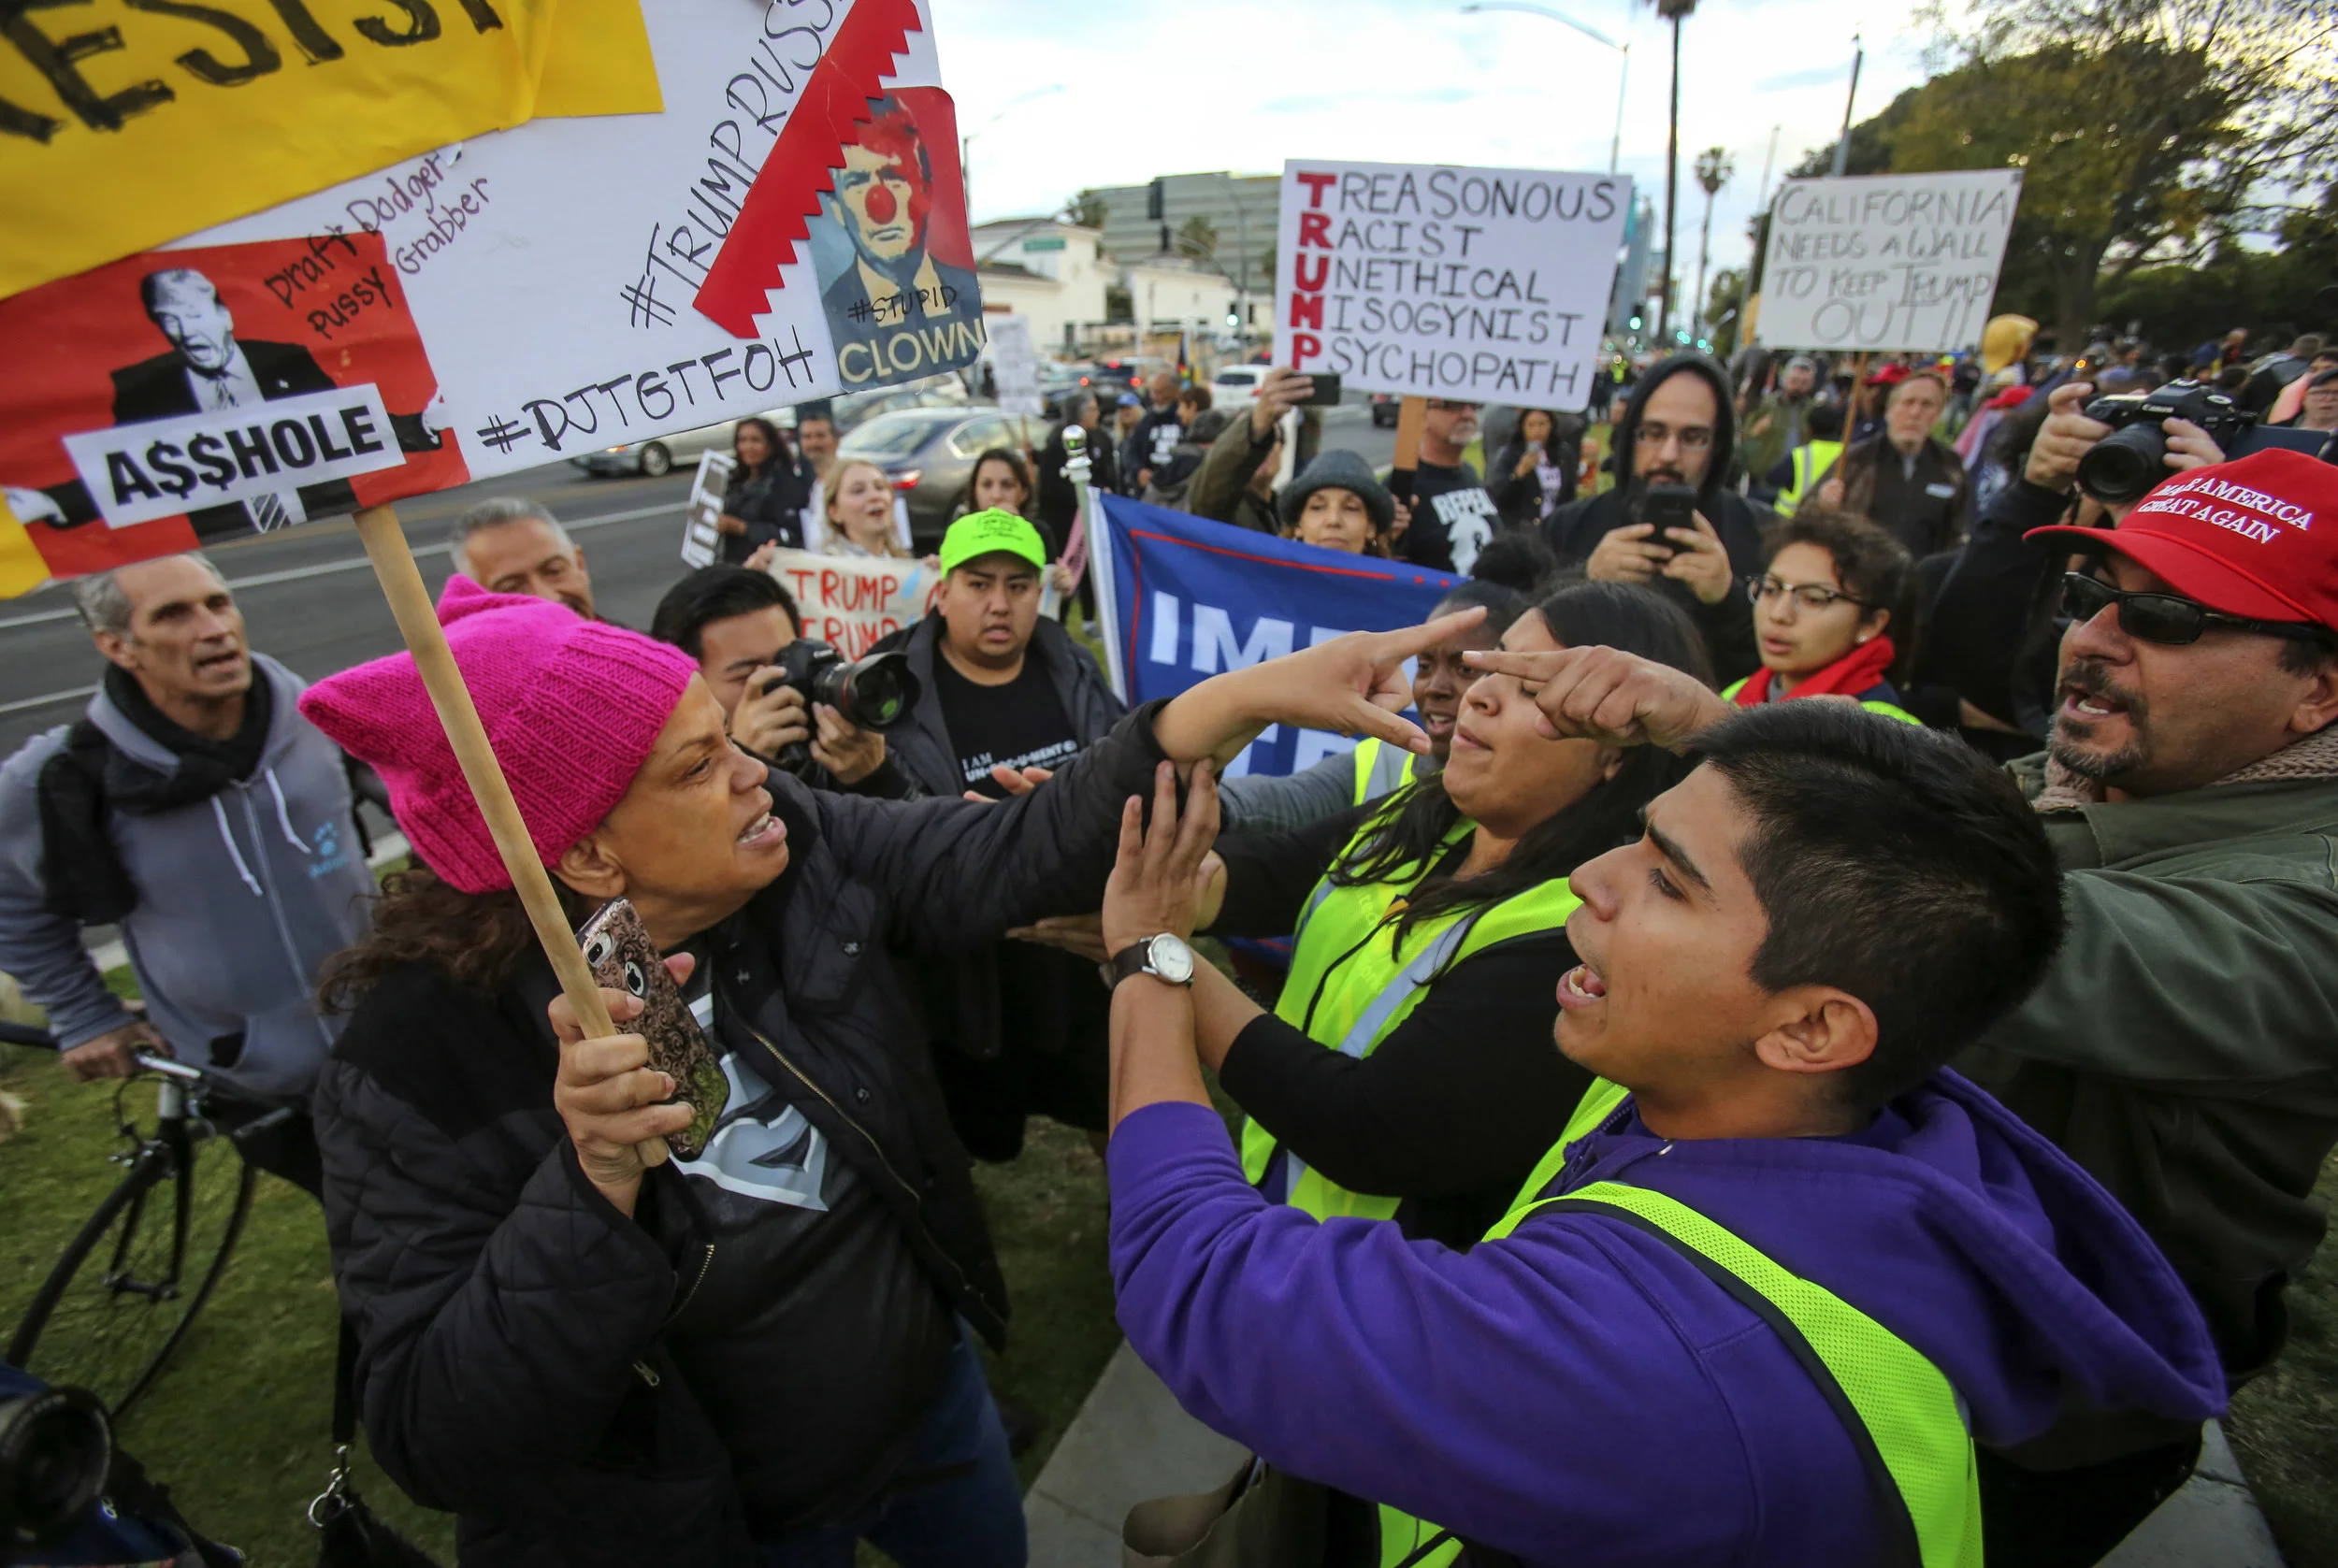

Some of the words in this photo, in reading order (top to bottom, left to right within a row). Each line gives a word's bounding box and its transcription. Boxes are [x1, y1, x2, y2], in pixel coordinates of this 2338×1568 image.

[1296, 170, 1616, 223] TREASONOUS
[1775, 185, 2009, 226] CALIFORNIA
[264, 223, 358, 310] Draft
[345, 151, 445, 237] Dodger
[395, 177, 490, 275] Grabber
[1298, 212, 1483, 257] RACIST
[1773, 231, 1869, 262] NEEDS
[846, 284, 958, 324] #STUPID
[1295, 252, 1550, 305] UNETHICAL
[1770, 266, 1819, 300] TO
[1826, 268, 1890, 299] KEEP
[1890, 258, 1996, 308] TRUMP
[1289, 292, 1583, 346] MISOGYNIST
[838, 315, 988, 384] CLOWN
[1292, 333, 1580, 395] PSYCHOPATH
[2189, 505, 2281, 544] AGAIN
[2194, 477, 2315, 531] AMERICA
[785, 568, 899, 613] TRUMP
